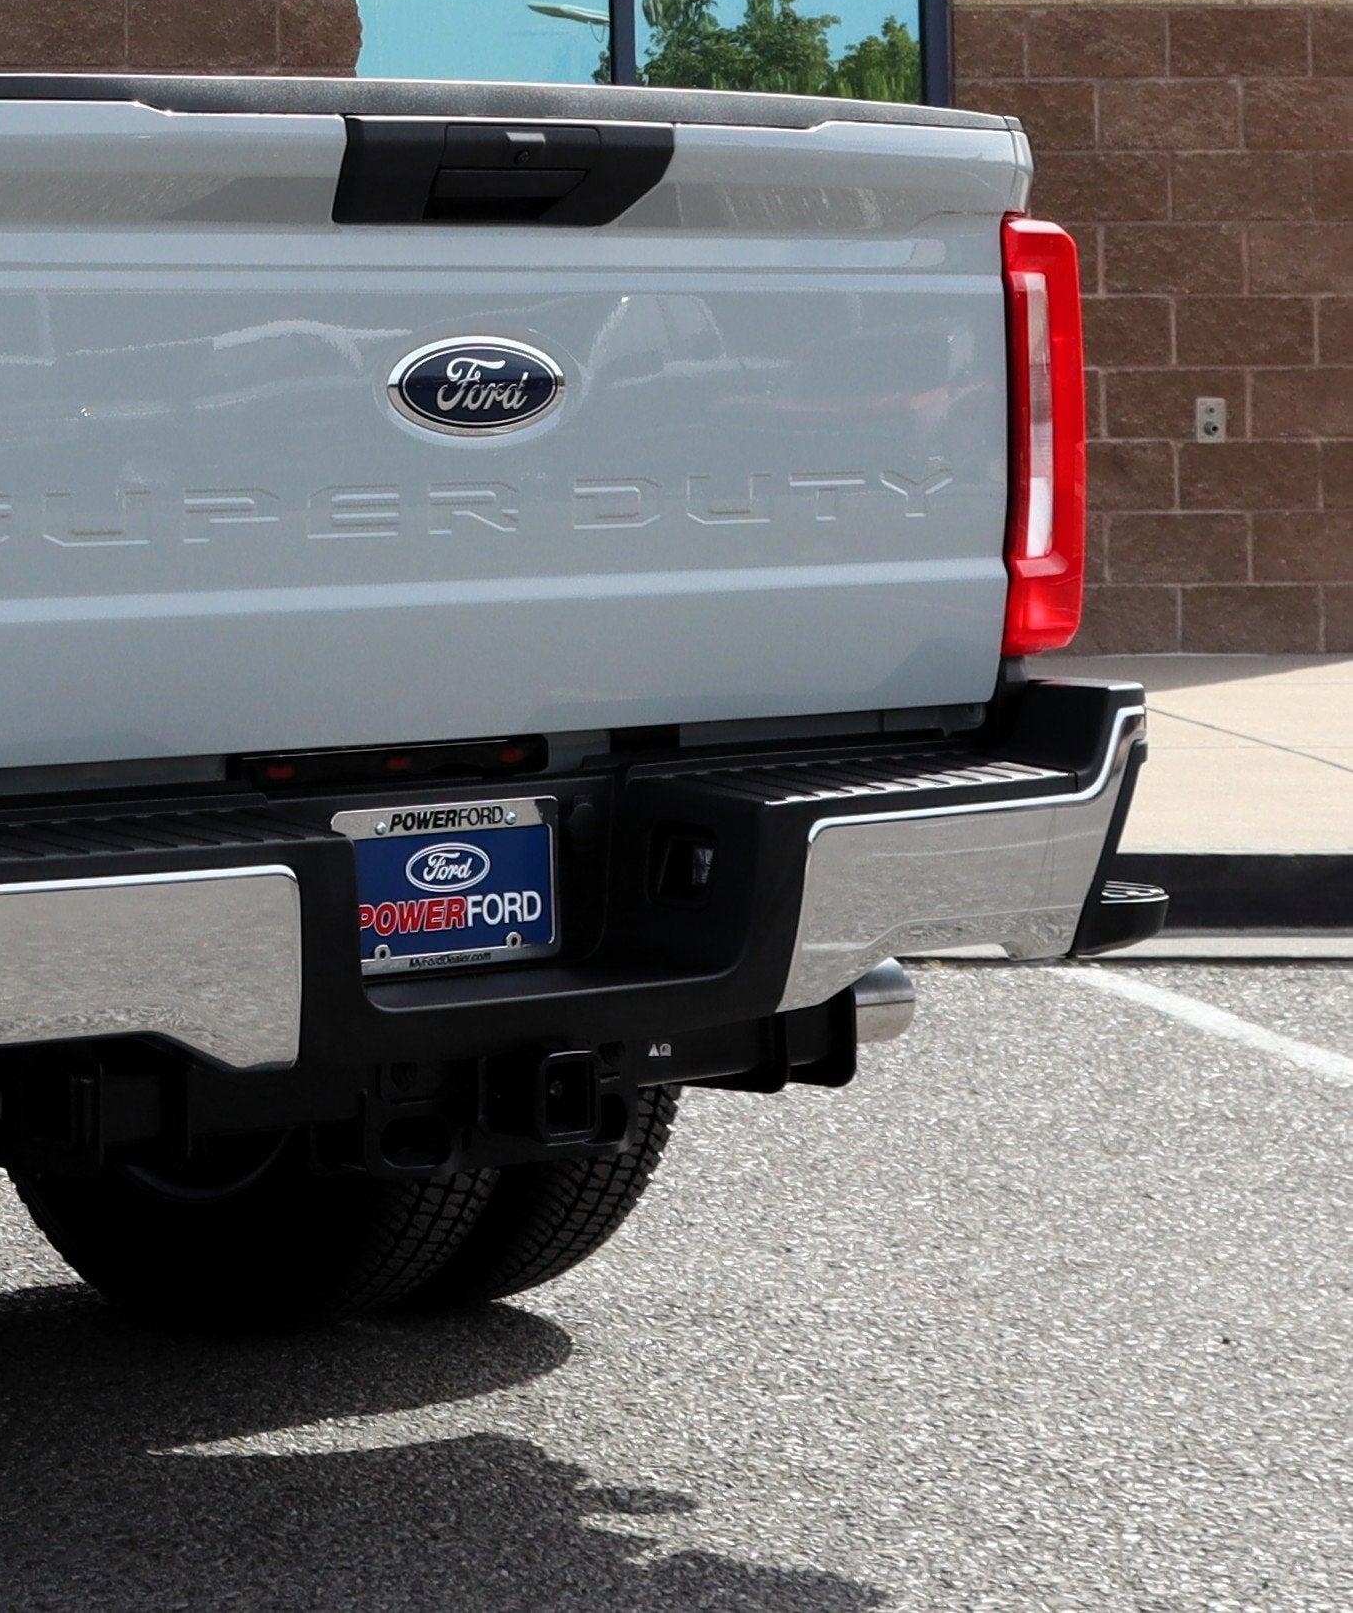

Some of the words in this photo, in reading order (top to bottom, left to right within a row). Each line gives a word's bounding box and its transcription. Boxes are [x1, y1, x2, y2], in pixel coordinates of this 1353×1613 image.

[436, 356, 530, 411] Ford
[571, 466, 956, 532] DUTY
[388, 805, 504, 833] POWERFORD
[422, 851, 473, 882] Ford
[358, 890, 543, 936] POWERFORD
